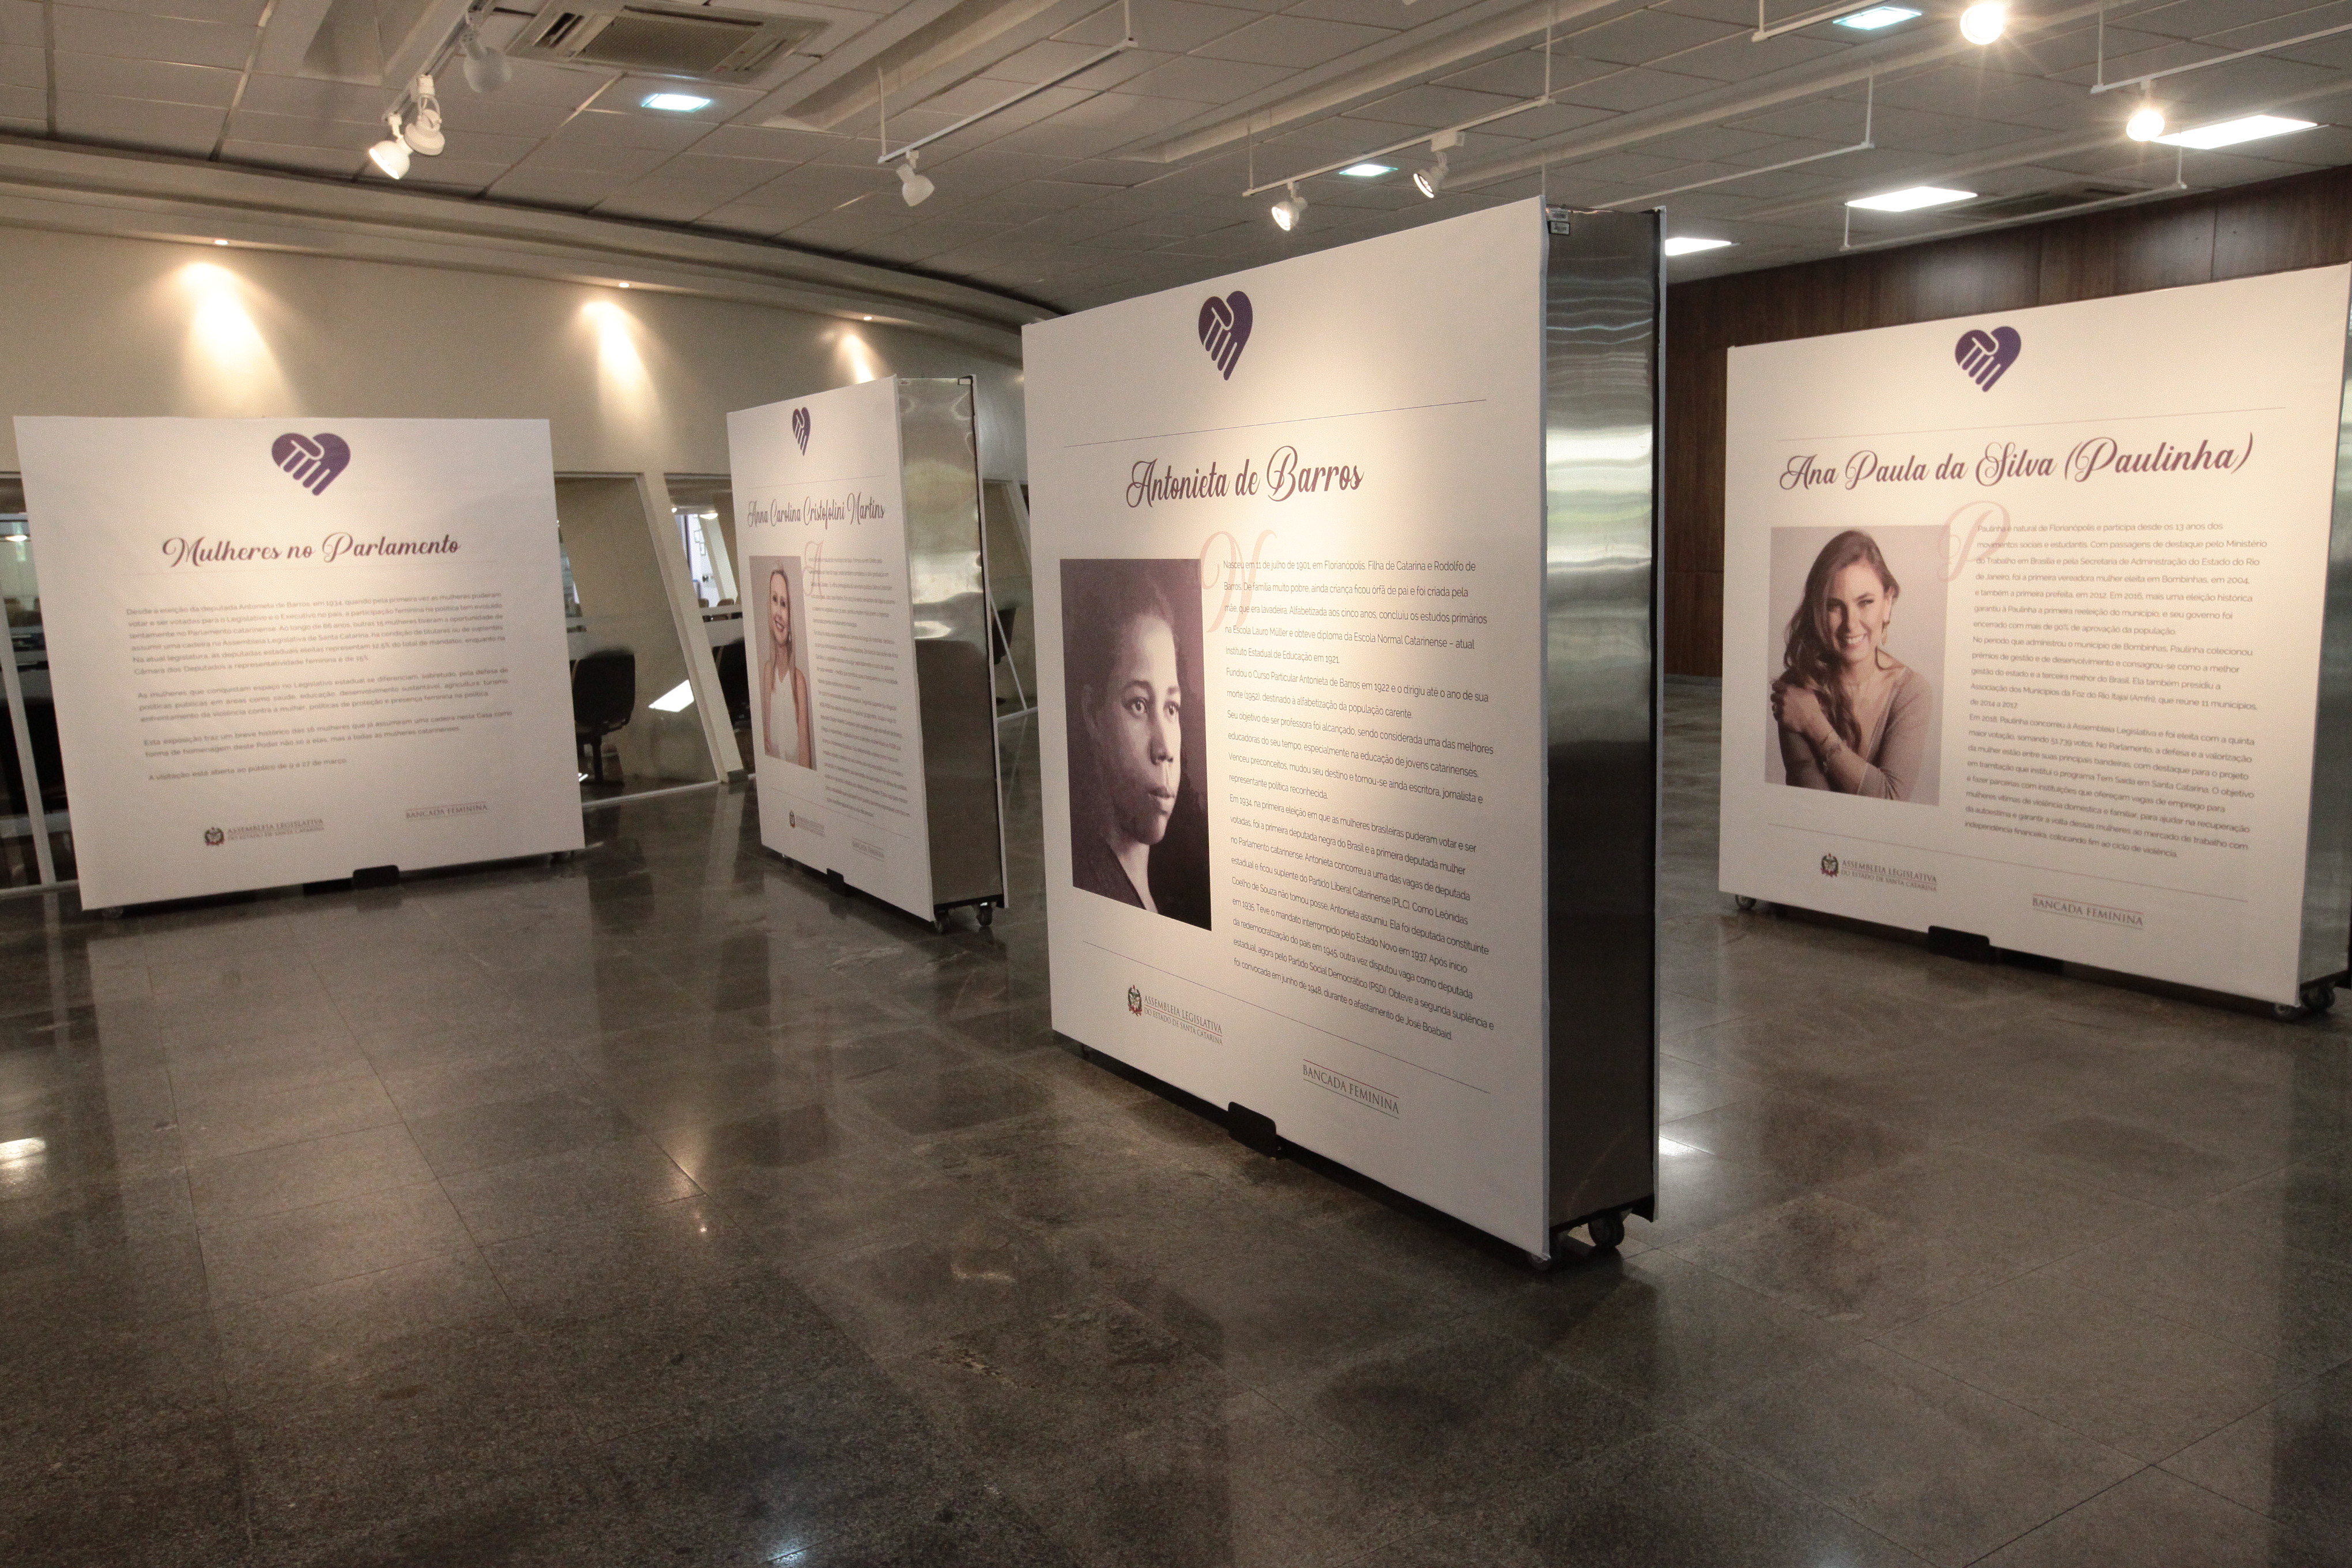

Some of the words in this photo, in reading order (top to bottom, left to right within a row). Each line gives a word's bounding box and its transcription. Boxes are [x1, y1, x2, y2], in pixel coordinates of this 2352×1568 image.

[1126, 458, 1230, 507] Antonieta
[1235, 458, 1261, 496] de
[1267, 446, 1365, 502] Barros
[1780, 454, 1838, 490] Ana
[1845, 450, 1929, 490] Paula
[1935, 453, 1968, 481] da
[1976, 442, 2058, 487] Silva
[2064, 432, 2253, 483] (Paulinha)
[747, 500, 768, 527] Anna
[770, 499, 801, 527] Carolina
[803, 496, 845, 530] Cristofolini
[847, 492, 885, 525] Martins
[163, 537, 282, 568] Mulheres
[287, 545, 316, 559] no
[322, 532, 462, 563] Parlamento
[1223, 560, 1244, 569] Nasceu
[1262, 560, 1270, 569] de
[1271, 560, 1286, 571] julho
[1287, 560, 1295, 569] de
[1324, 560, 1366, 572] Florianópolis.
[1368, 560, 1384, 570] Filha
[1385, 560, 1394, 570] de
[1396, 560, 1426, 570] Catarina
[1434, 560, 1464, 570] Rodolfo
[1465, 560, 1475, 570] de
[1232, 624, 1250, 634] Escola
[1252, 625, 1268, 635] Lauro
[1269, 627, 1287, 636] Müller
[1294, 628, 1316, 638] obteve
[1317, 629, 1342, 641] diploma
[1344, 631, 1352, 640] da
[1354, 631, 1375, 642] Escola
[1377, 633, 1403, 644] Normal
[1404, 634, 1447, 647] Catarinense
[1455, 638, 1474, 649] atual
[1227, 709, 1238, 719] Seu
[1239, 711, 1260, 723] objetivo
[1261, 713, 1269, 723] de
[1280, 717, 1311, 729] professora
[1313, 720, 1321, 730] foi
[1358, 728, 1378, 738] sendo
[1379, 731, 1422, 744] considerada
[1424, 737, 1440, 747] uma
[1442, 737, 1455, 749] das
[1457, 741, 1493, 754] melhores
[1228, 730, 1260, 744] educadoras
[1261, 734, 1269, 745] do
[1270, 738, 1280, 747] seu
[1281, 738, 1302, 751] tempo,
[1303, 744, 1350, 757] especialmente
[1351, 751, 1359, 759] na
[1360, 750, 1393, 765] educação
[1395, 755, 1404, 766] de
[1405, 756, 1429, 770] jovens
[1430, 763, 1479, 777] catarinenses.
[1228, 751, 1249, 764] Venceu
[1250, 757, 1288, 771] preconceitos,
[1289, 763, 1310, 774] mudou
[1312, 768, 1323, 776] seu
[1324, 767, 1348, 780] destino
[1355, 773, 1387, 787] tornou-se
[1389, 778, 1407, 790] ainda
[1408, 783, 1441, 797] escritora,
[1443, 787, 1476, 802] jornalista
[1477, 795, 1483, 803] e
[1229, 774, 1267, 787] representante
[1290, 785, 1328, 799] reconhecida.
[1842, 860, 1886, 874] ASSEMBLEIA
[1889, 868, 1937, 882] LEGISLATIVA
[1231, 876, 1250, 889] Coelho
[1252, 881, 1259, 892] de
[1260, 883, 1276, 896] Souza
[1278, 888, 1288, 900] não
[1290, 892, 1309, 905] tomou
[1310, 899, 1329, 912] posse,
[1330, 902, 1359, 919] Antonieta
[1390, 918, 1400, 930] Ela
[1401, 921, 1410, 933] foi
[1411, 924, 1445, 943] deputada
[1446, 936, 1489, 954] constituinte
[2033, 897, 2082, 916] BANCADA
[2086, 907, 2143, 926] FEMININA
[1144, 996, 1180, 1016] ASSEMBLEIA
[1182, 1009, 1222, 1034] LEGISLATIVA
[1144, 1007, 1152, 1016] DO
[1153, 1011, 1171, 1024] ESTADO
[1173, 1019, 1179, 1027] DE
[1180, 1022, 1196, 1034] SANTA
[1197, 1029, 1223, 1046] CATARINA
[1303, 1064, 1346, 1092] BANCADA
[1349, 1083, 1399, 1114] FEMININA
